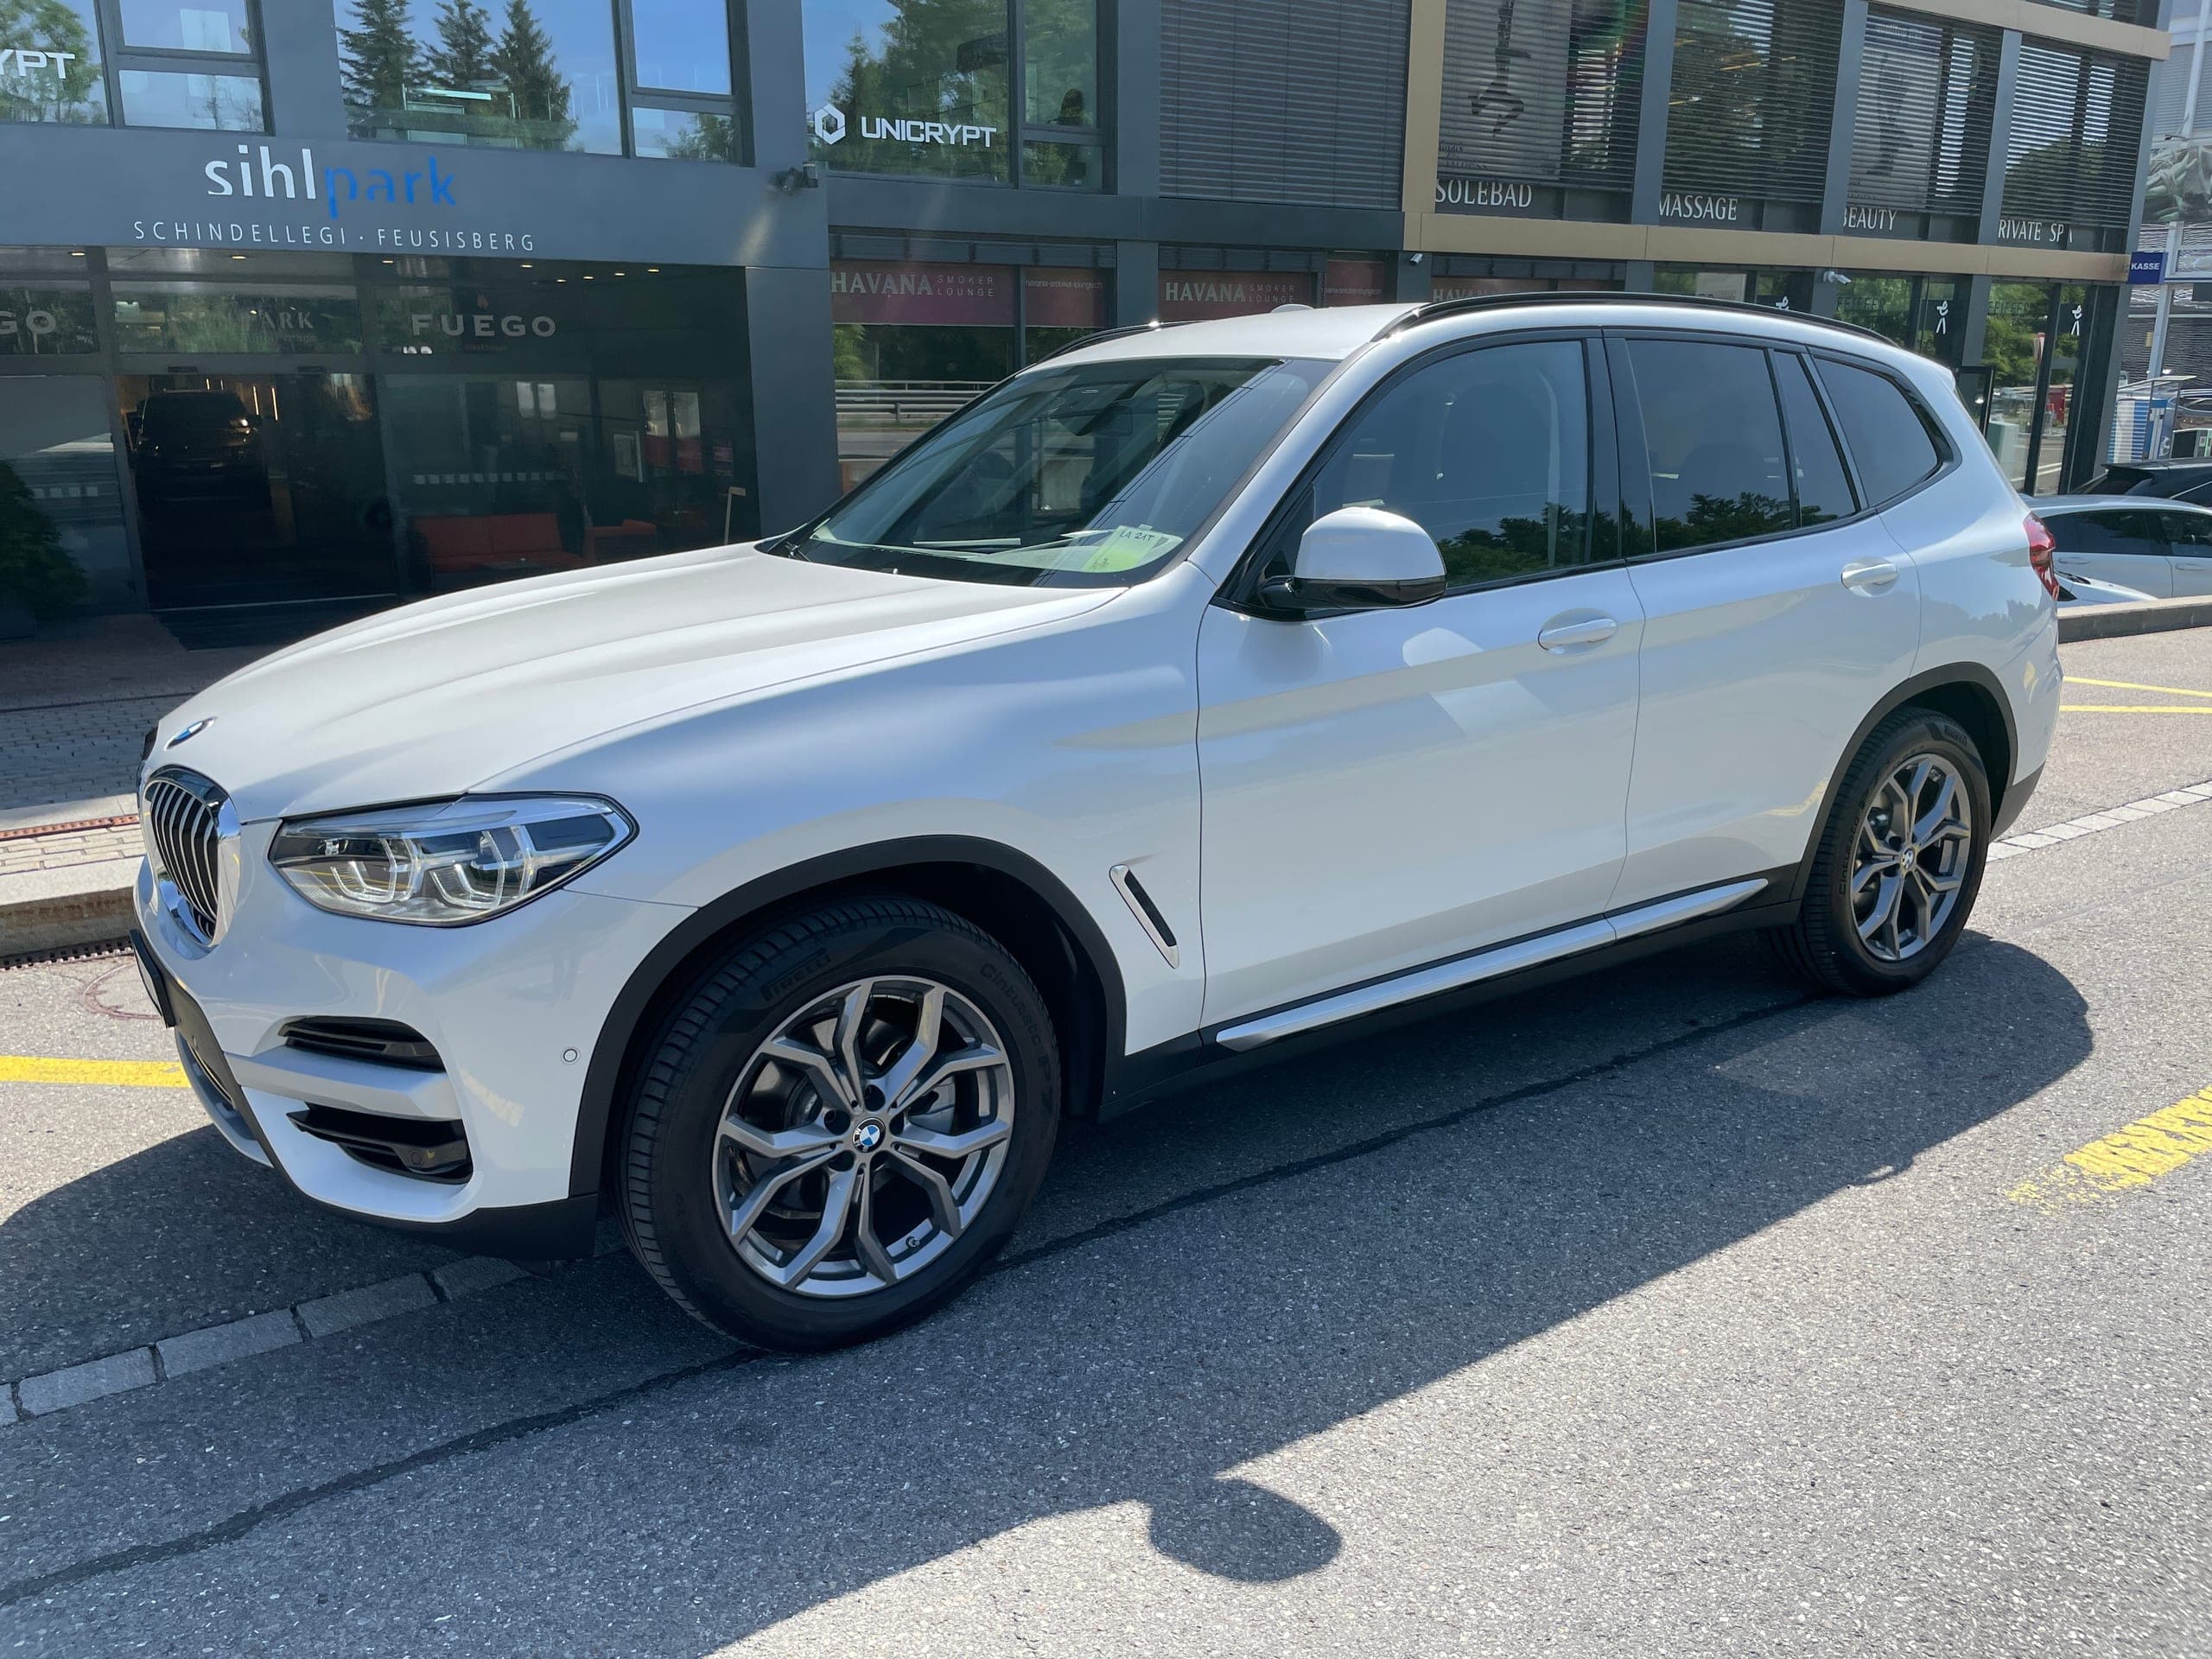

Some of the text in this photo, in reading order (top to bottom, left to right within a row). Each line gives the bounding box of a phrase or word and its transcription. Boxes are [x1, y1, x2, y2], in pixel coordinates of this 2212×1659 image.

[861, 116, 997, 148] UNICRYPT
[1435, 179, 1533, 207] SOLEBAD
[1659, 194, 1738, 220] MASSAGE
[133, 220, 534, 251] SCHINDELLEGI FEUSISBERG
[1998, 219, 2043, 241] RIVATE
[2130, 262, 2161, 270] KASSE
[830, 271, 994, 296] HAVANA SMOKER
[938, 288, 994, 297] LOUNGE
[1166, 282, 1247, 302] HAVANA
[1249, 295, 1294, 303] LOUNGE
[0, 310, 56, 334] GO
[260, 311, 315, 329] ARK
[410, 314, 556, 338] FUEGO
